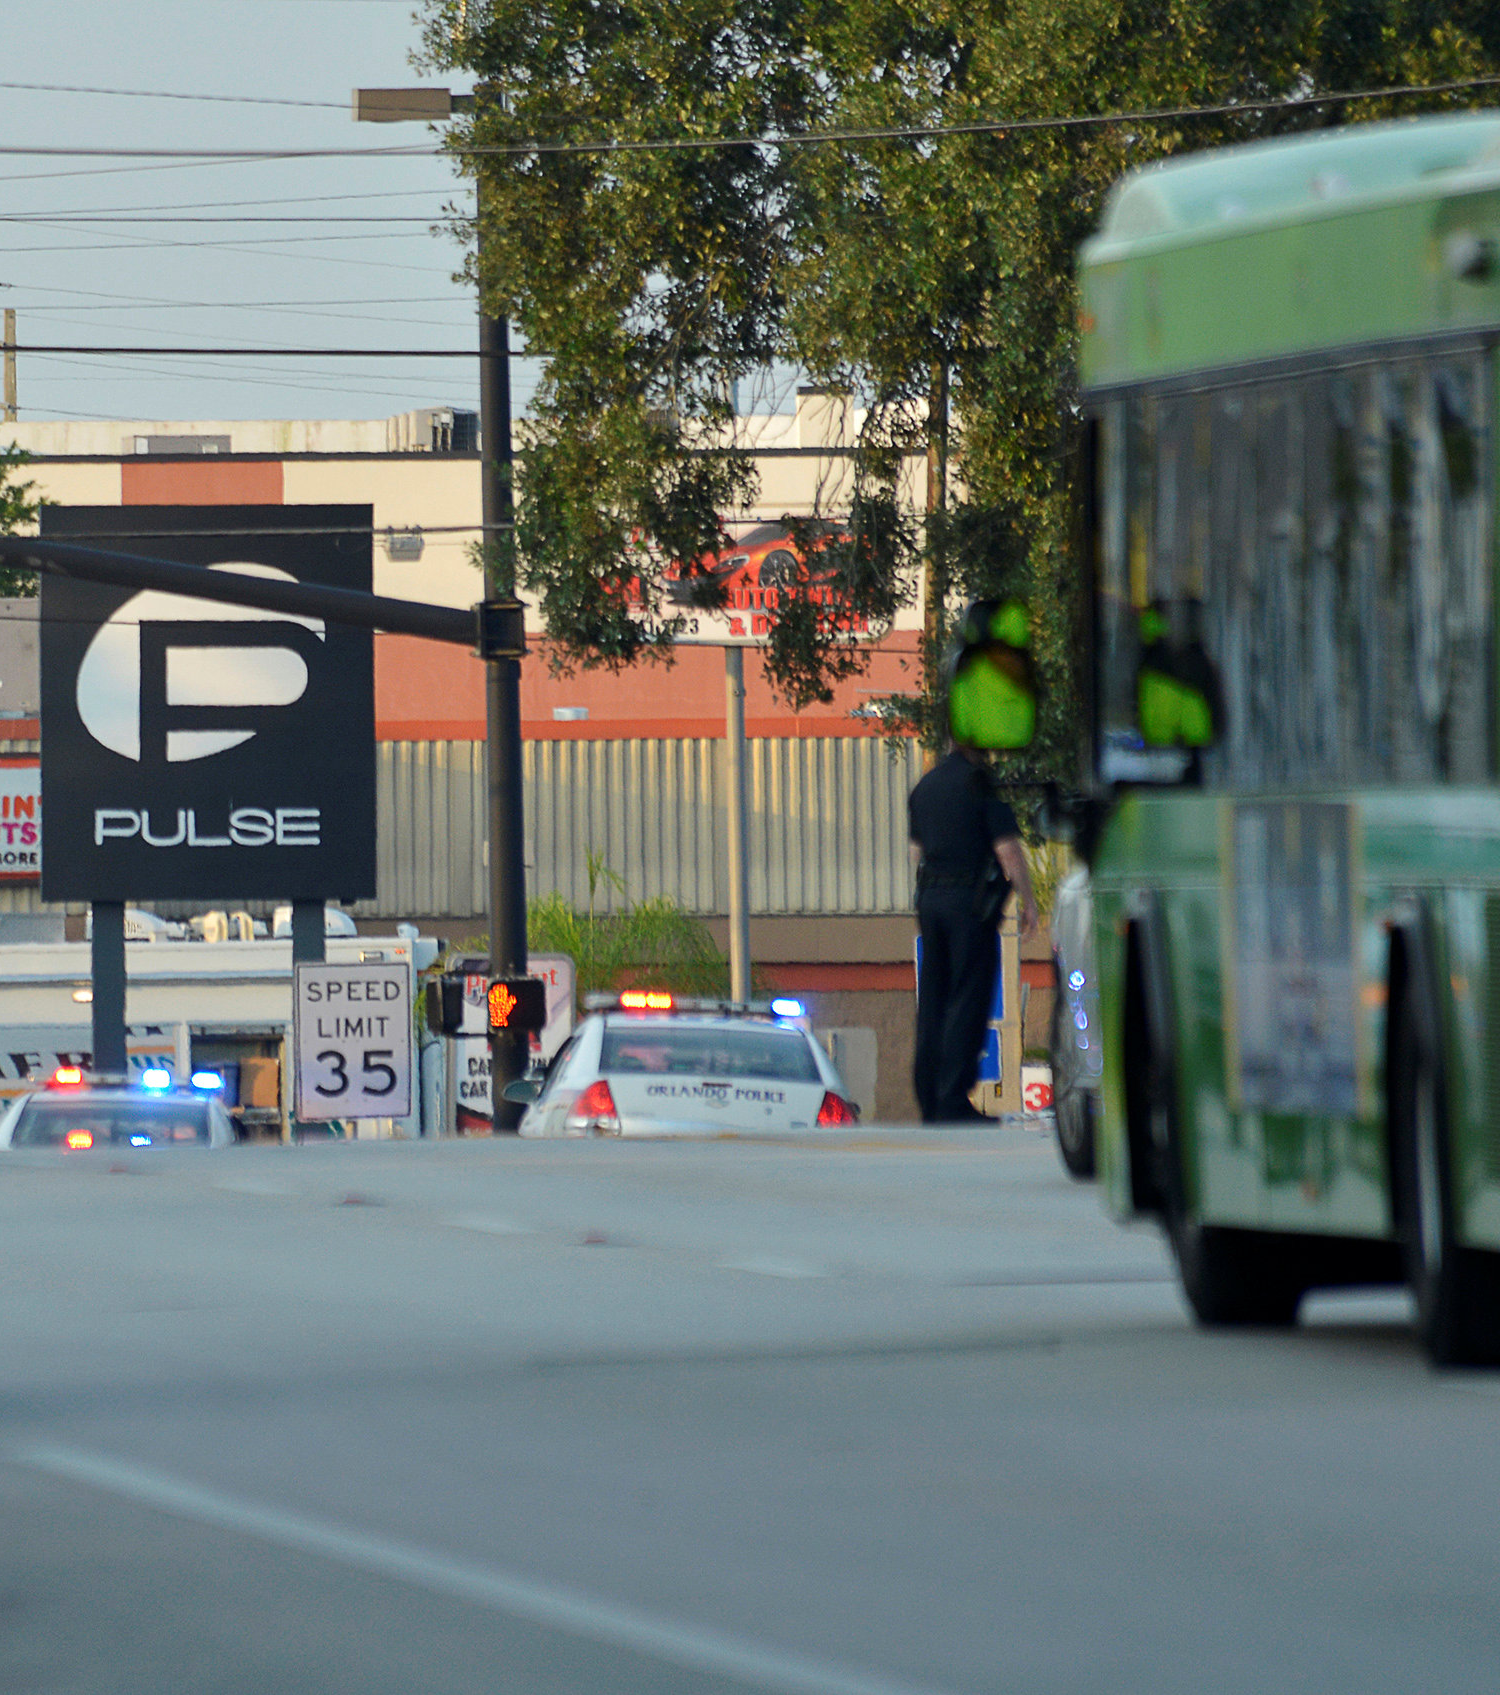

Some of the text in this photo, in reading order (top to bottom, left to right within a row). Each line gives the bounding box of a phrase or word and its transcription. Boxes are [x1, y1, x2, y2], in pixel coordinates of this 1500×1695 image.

[95, 808, 320, 847] PULSE
[307, 980, 400, 1002] SPEED
[317, 1017, 390, 1038] LIMIT
[315, 1050, 397, 1098] 35
[647, 1084, 787, 1104] ORLANDO POLICE
